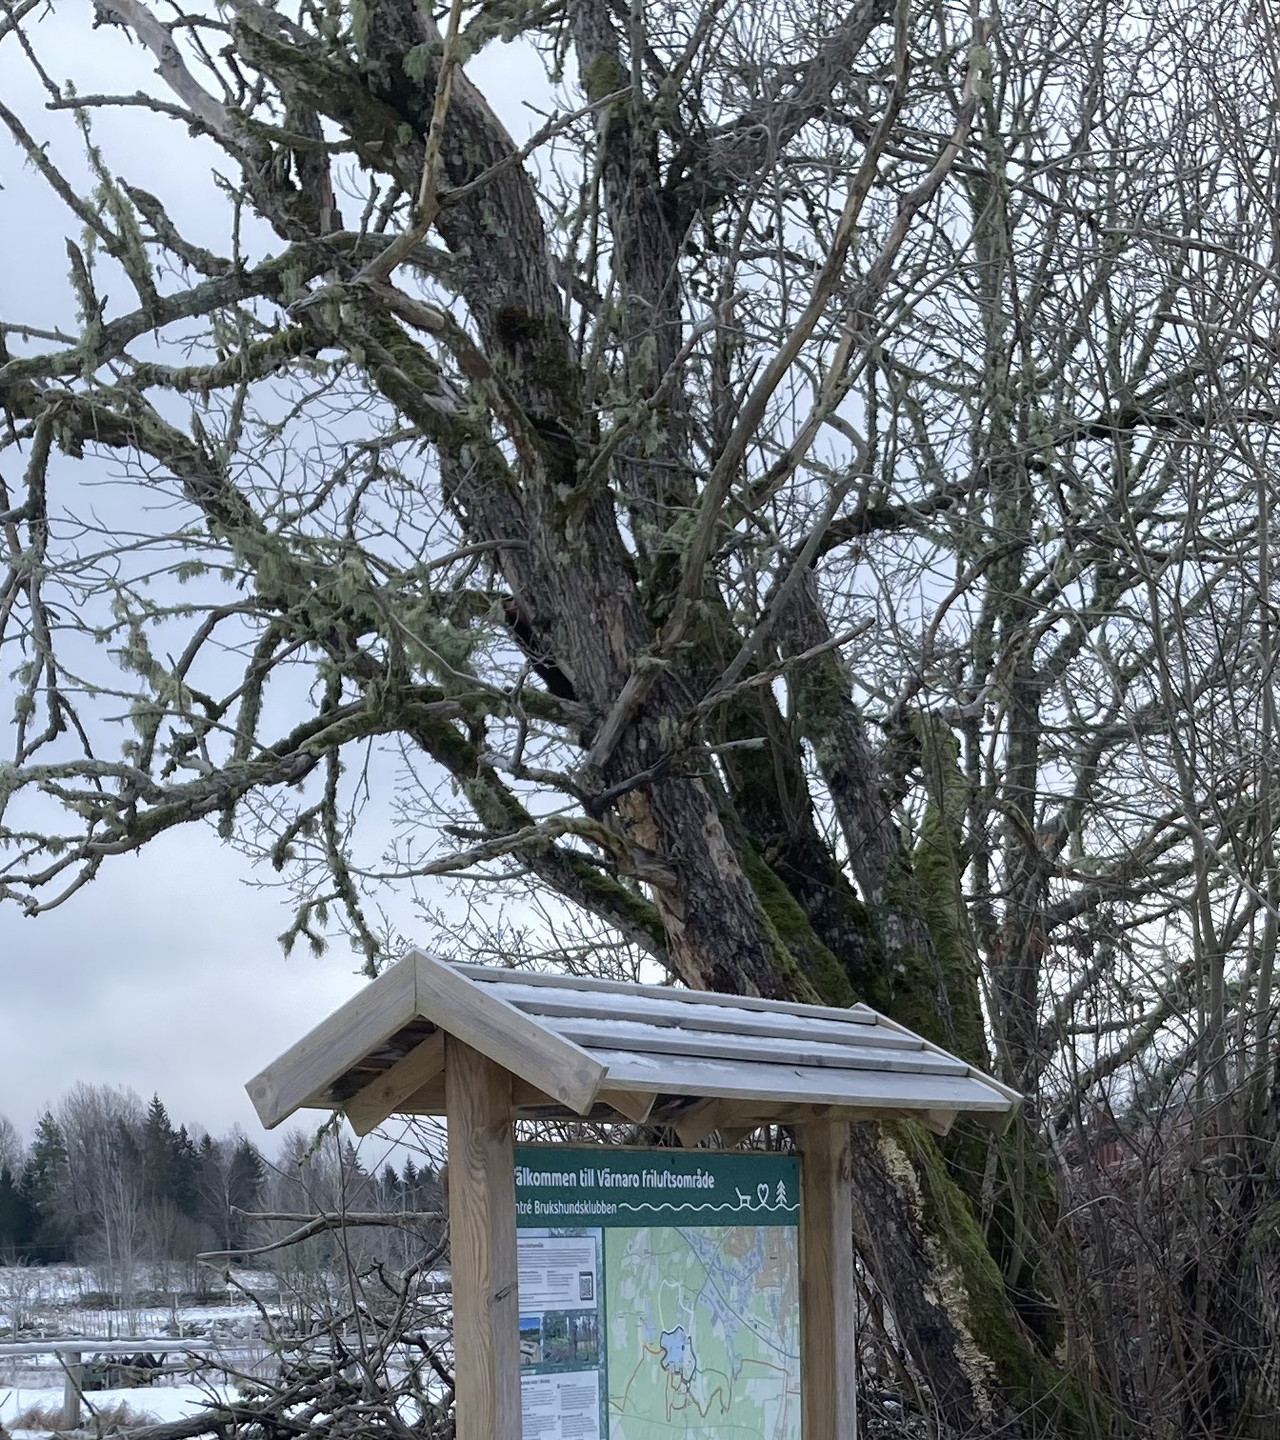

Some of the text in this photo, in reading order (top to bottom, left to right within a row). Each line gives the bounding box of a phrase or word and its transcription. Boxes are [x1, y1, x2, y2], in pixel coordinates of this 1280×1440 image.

[513, 1166, 715, 1189] älkommen till Värnaro friluftsområde
[515, 1198, 617, 1215] ntré Brukshundsklubben
